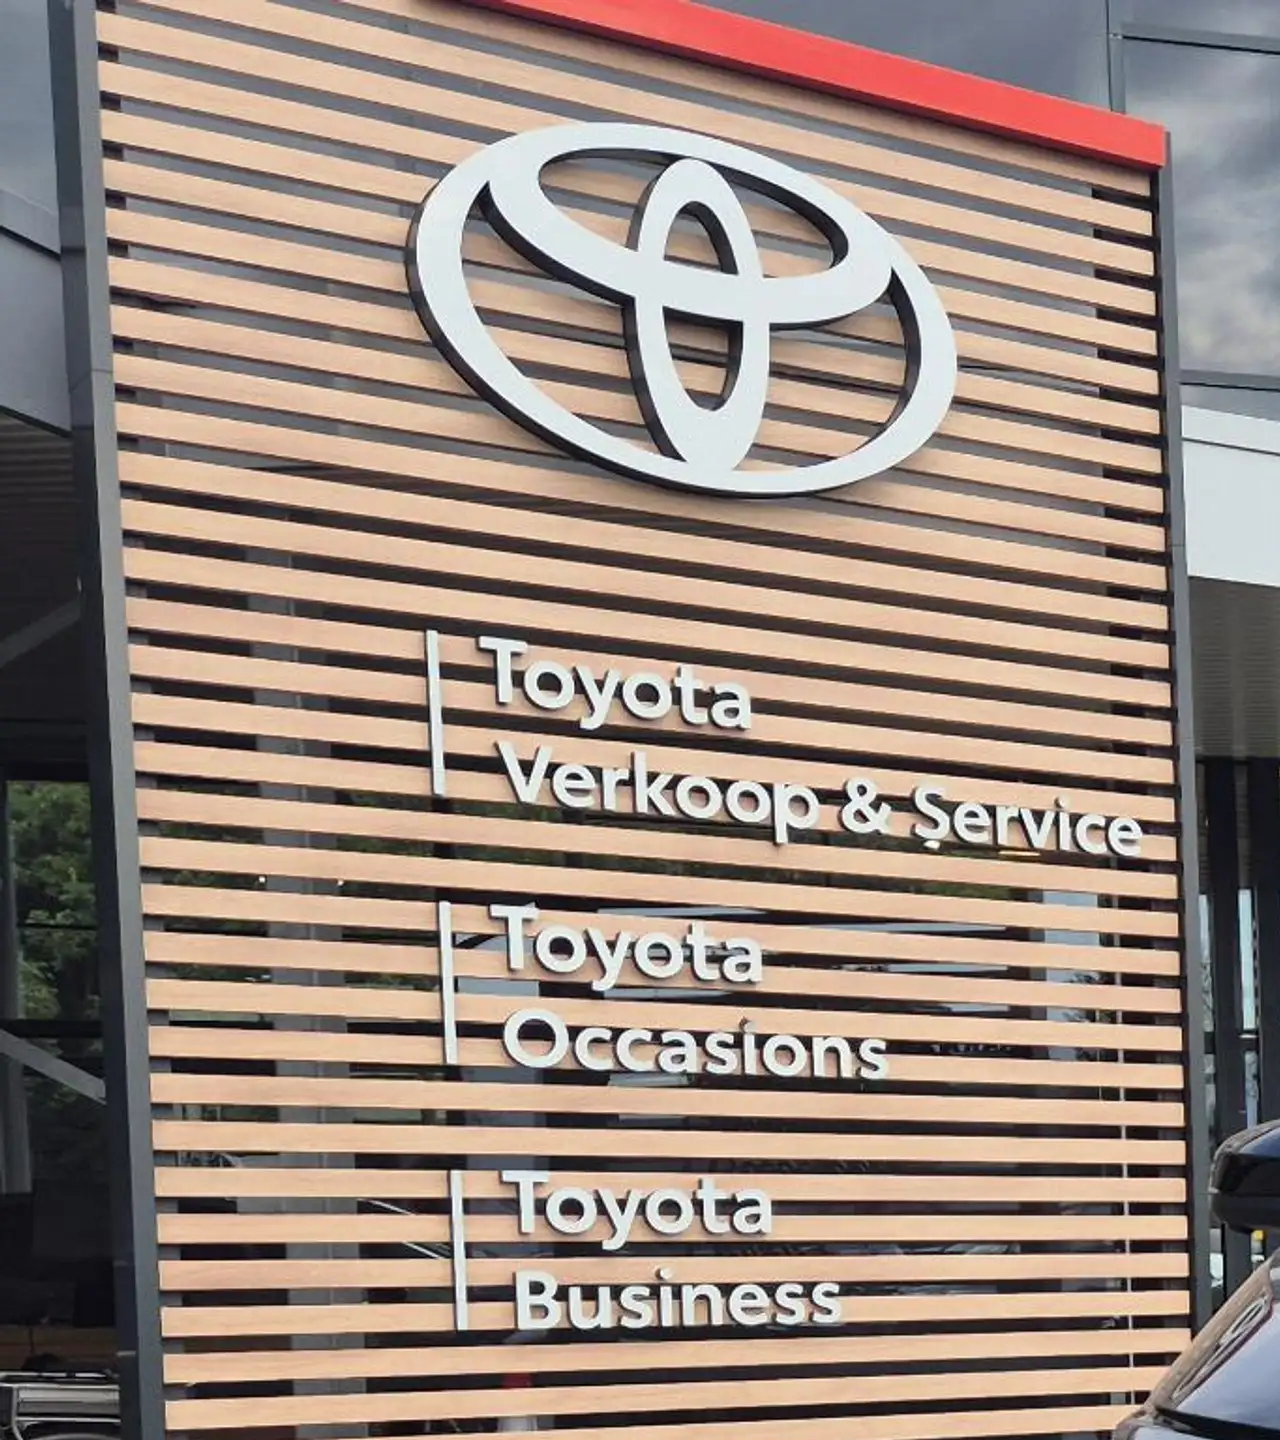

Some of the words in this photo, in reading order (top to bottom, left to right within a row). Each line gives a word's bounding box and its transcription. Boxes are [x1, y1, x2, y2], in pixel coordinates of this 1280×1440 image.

[478, 635, 753, 731] Toyota
[495, 741, 819, 845] Verkoop
[840, 779, 891, 834] &
[912, 784, 1144, 857] Service
[490, 902, 763, 991] Toyota
[502, 1008, 890, 1081] Occasions
[502, 1170, 774, 1249] Toyota
[514, 1269, 842, 1331] Business
